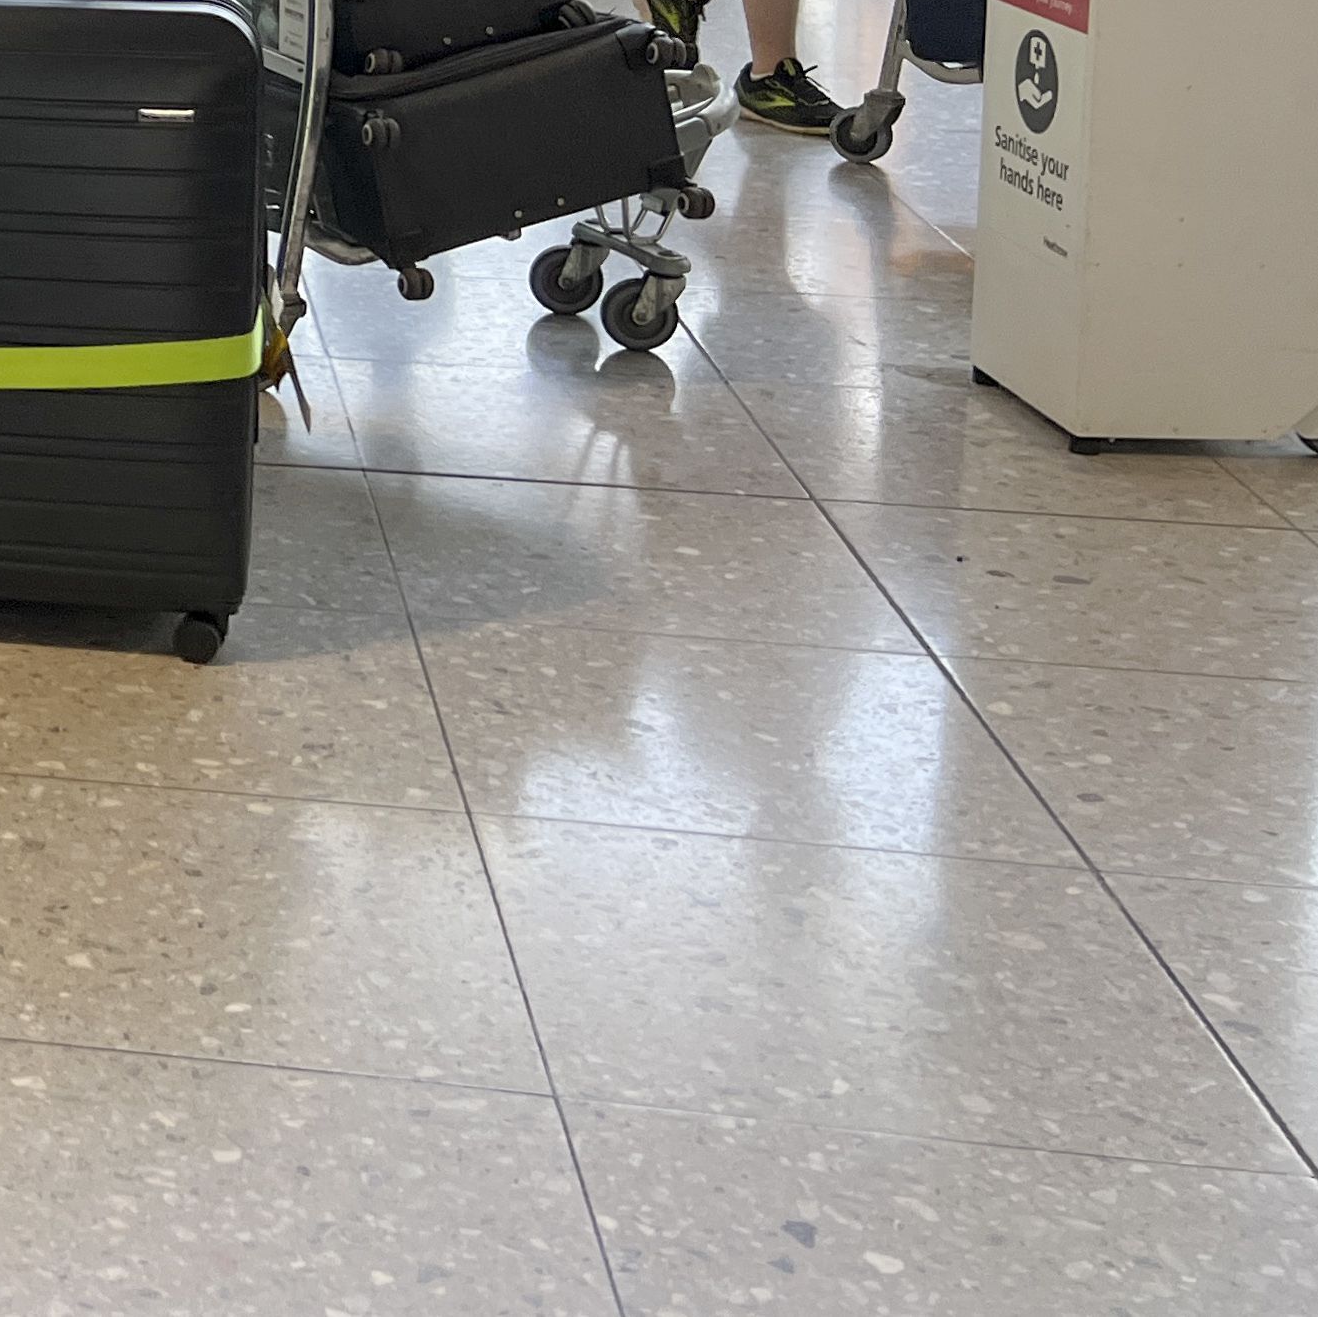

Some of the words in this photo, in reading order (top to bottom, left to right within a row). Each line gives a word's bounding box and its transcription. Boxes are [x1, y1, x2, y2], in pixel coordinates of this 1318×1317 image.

[995, 125, 1038, 166] Sanitise
[1040, 153, 1069, 181] your
[999, 157, 1034, 196] hands
[1037, 175, 1063, 212] here
